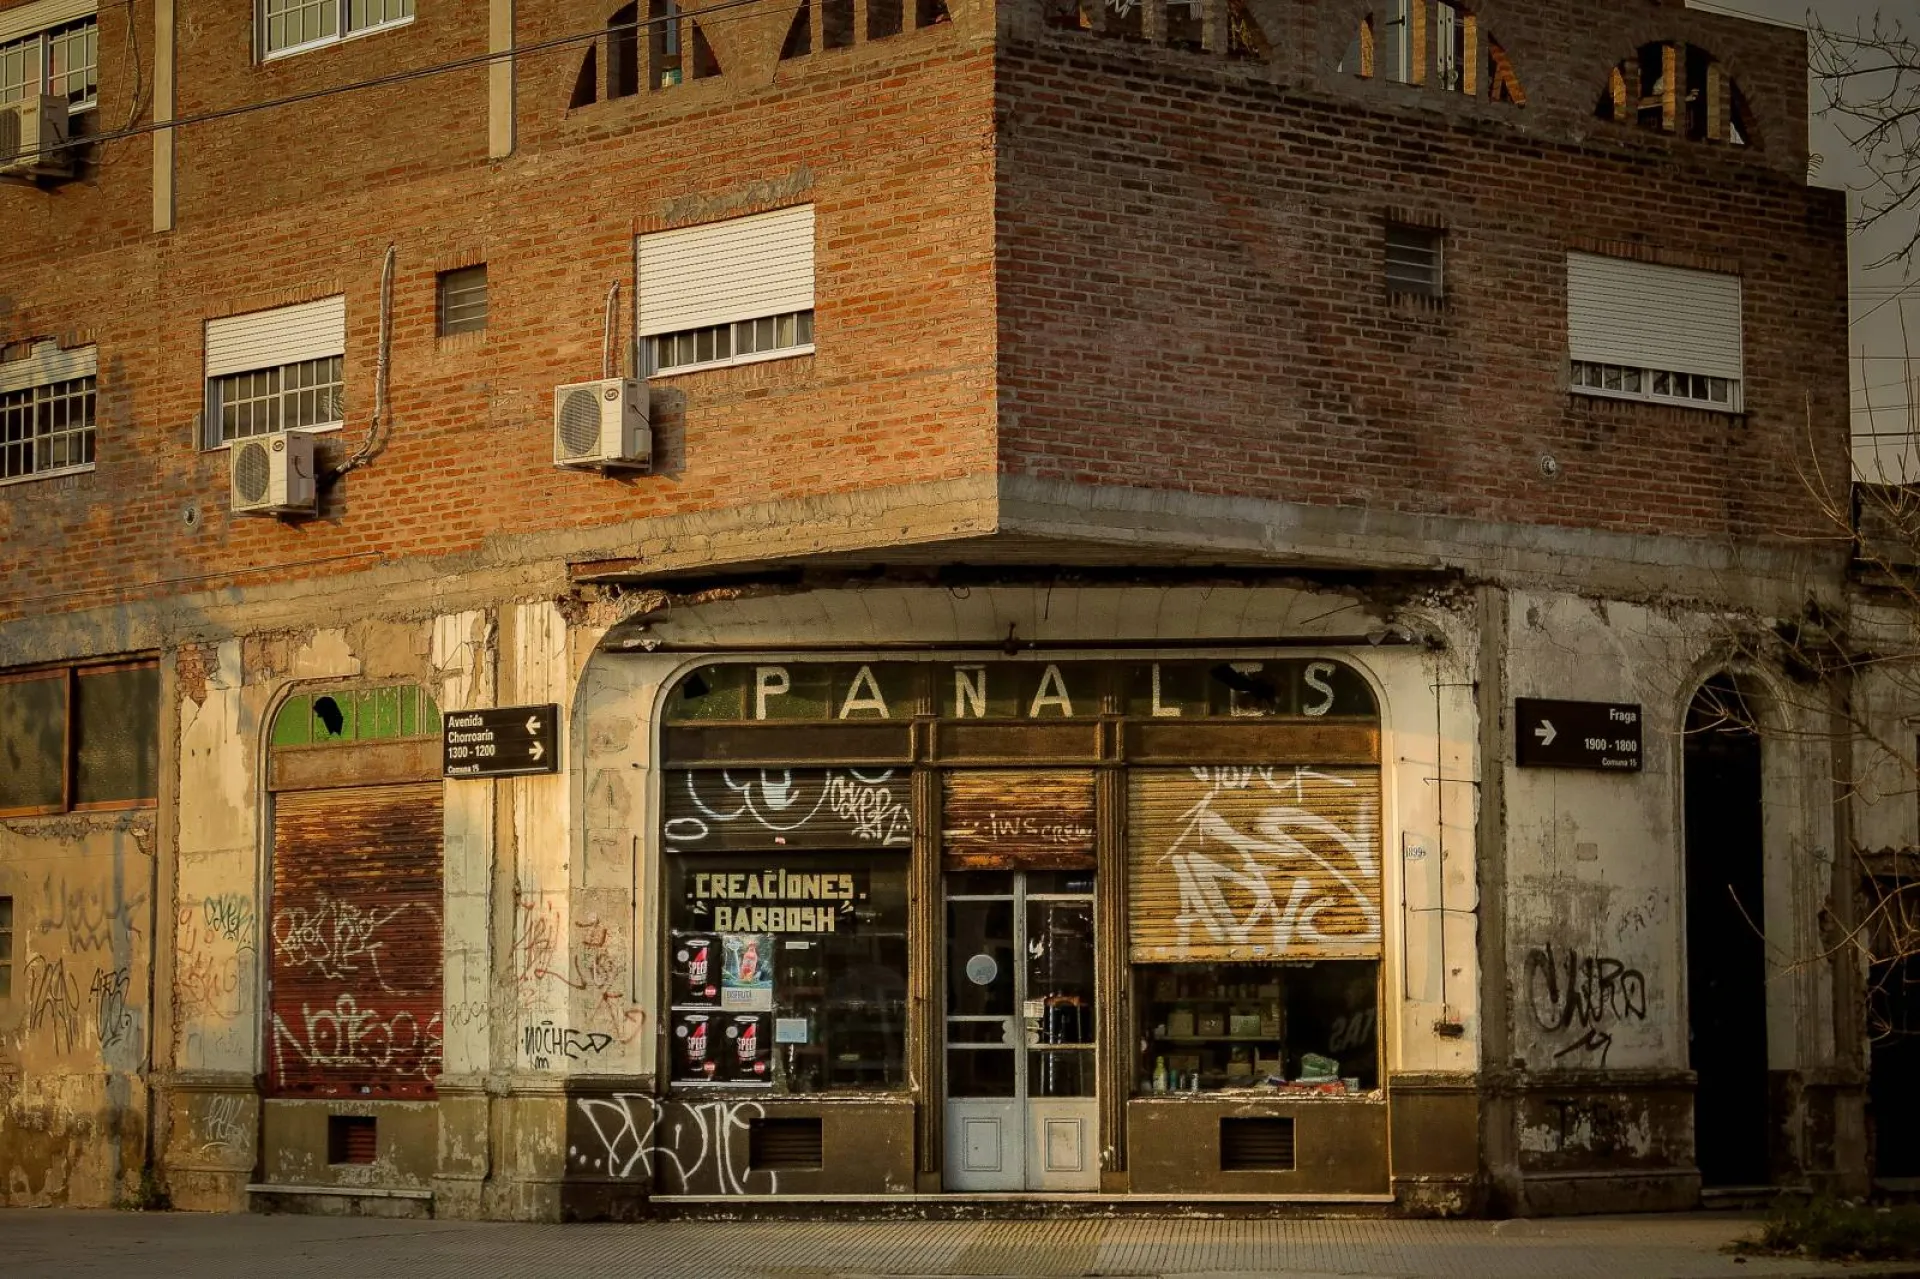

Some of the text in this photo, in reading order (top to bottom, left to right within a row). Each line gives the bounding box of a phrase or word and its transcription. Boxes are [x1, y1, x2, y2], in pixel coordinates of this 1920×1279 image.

[448, 714, 483, 728] Avenida
[1609, 708, 1637, 724] Fraga
[448, 729, 493, 743] Chorroarín
[448, 746, 468, 759] 1300
[475, 744, 496, 757] 1200
[1584, 738, 1606, 750] 1900
[1615, 740, 1637, 752] 1800
[1602, 757, 1628, 767] Comuna
[695, 868, 854, 899] CREACIONES
[714, 906, 835, 932] BARBOSH
